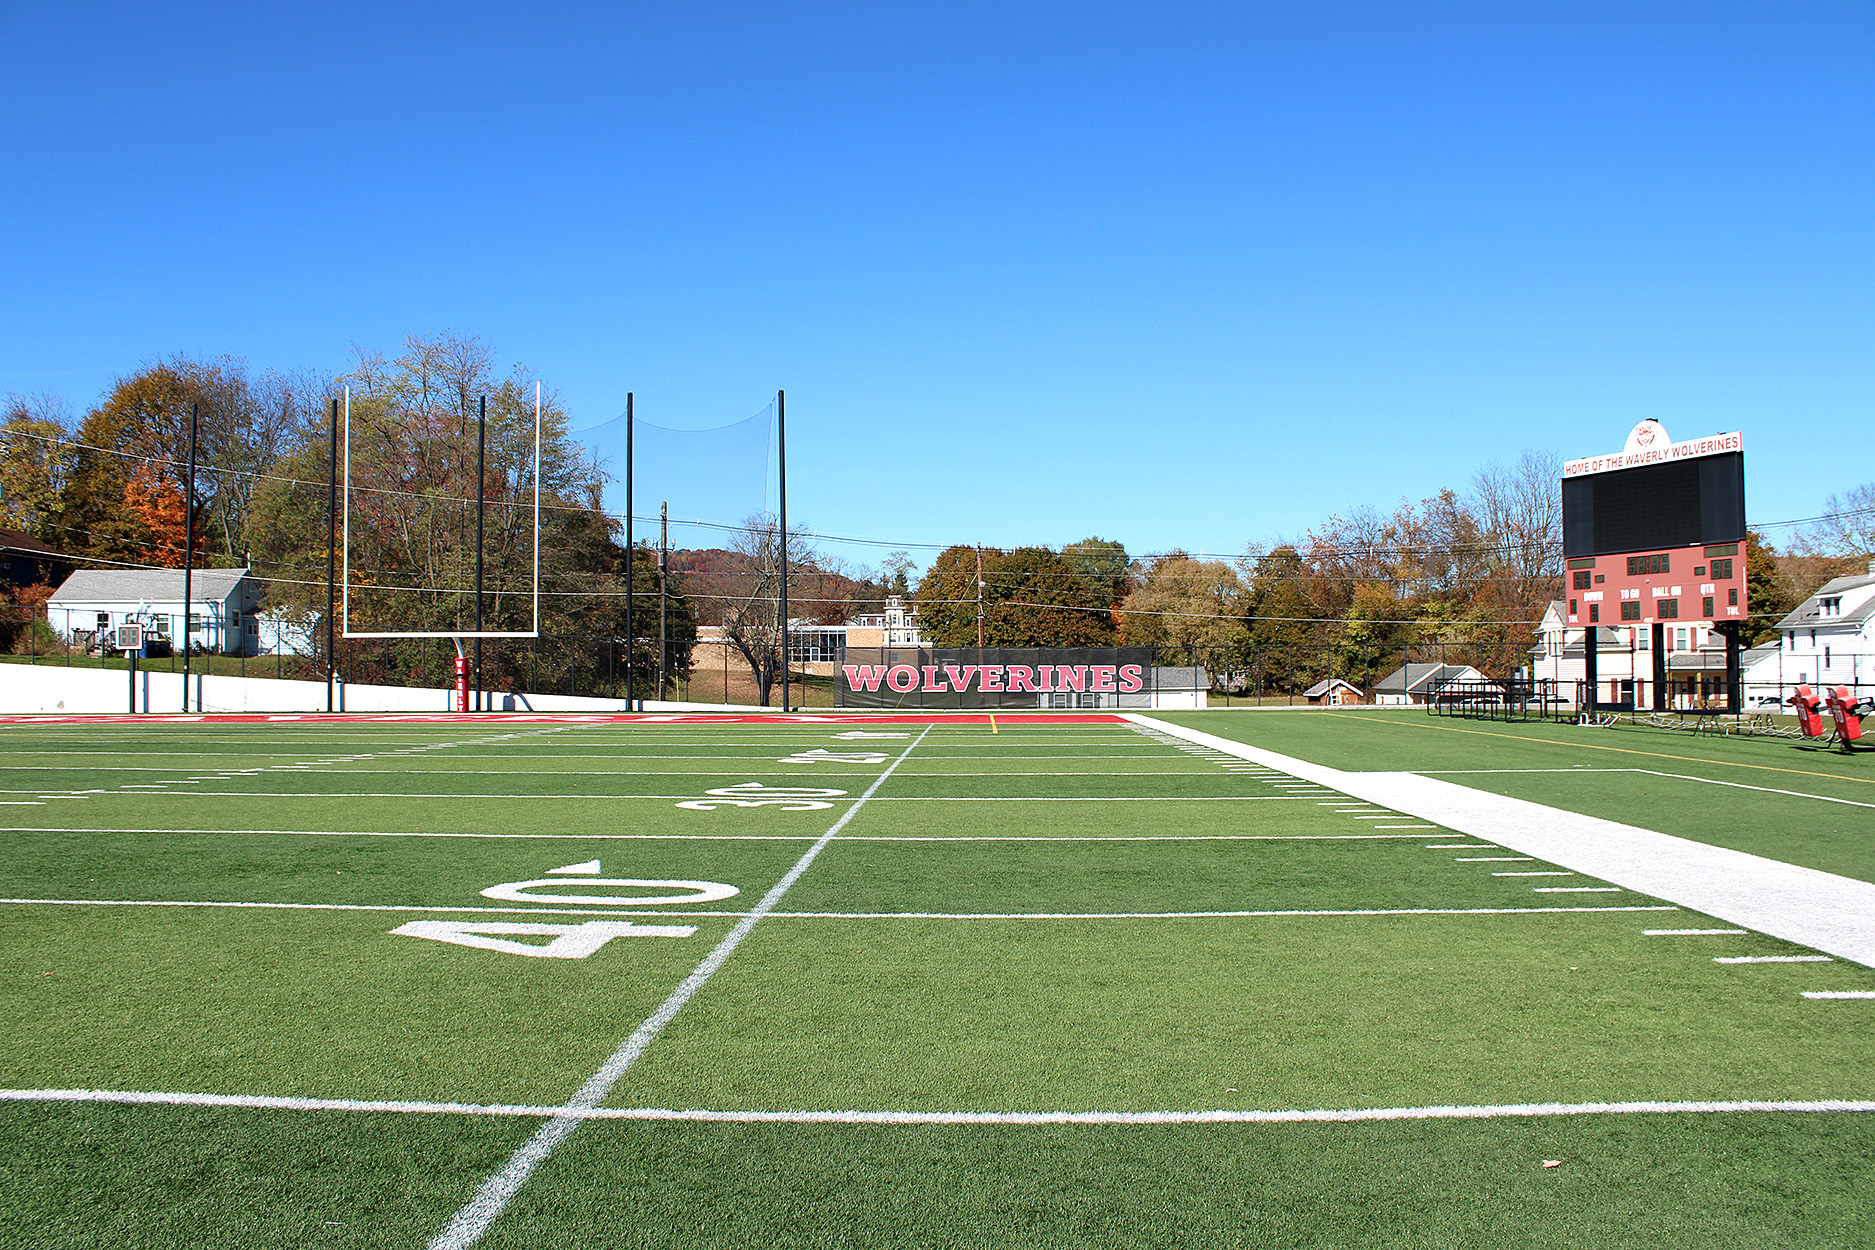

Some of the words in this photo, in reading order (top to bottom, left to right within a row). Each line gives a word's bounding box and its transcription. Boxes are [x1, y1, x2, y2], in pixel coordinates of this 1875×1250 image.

[1565, 461, 1590, 476] HOME
[1592, 460, 1603, 471] OF
[1606, 456, 1623, 469] THE
[1626, 448, 1669, 466] WAVERLY
[1672, 436, 1739, 458] WOLVERINES
[1583, 591, 1604, 602] DOWN
[1620, 589, 1629, 600] TO
[1629, 588, 1640, 599] GO
[1652, 586, 1670, 598] BALL
[1670, 585, 1681, 596] ON
[1700, 583, 1715, 595] QTR
[841, 665, 1144, 694] WOLVERINES
[674, 787, 848, 811] 30
[388, 878, 741, 959] 40
